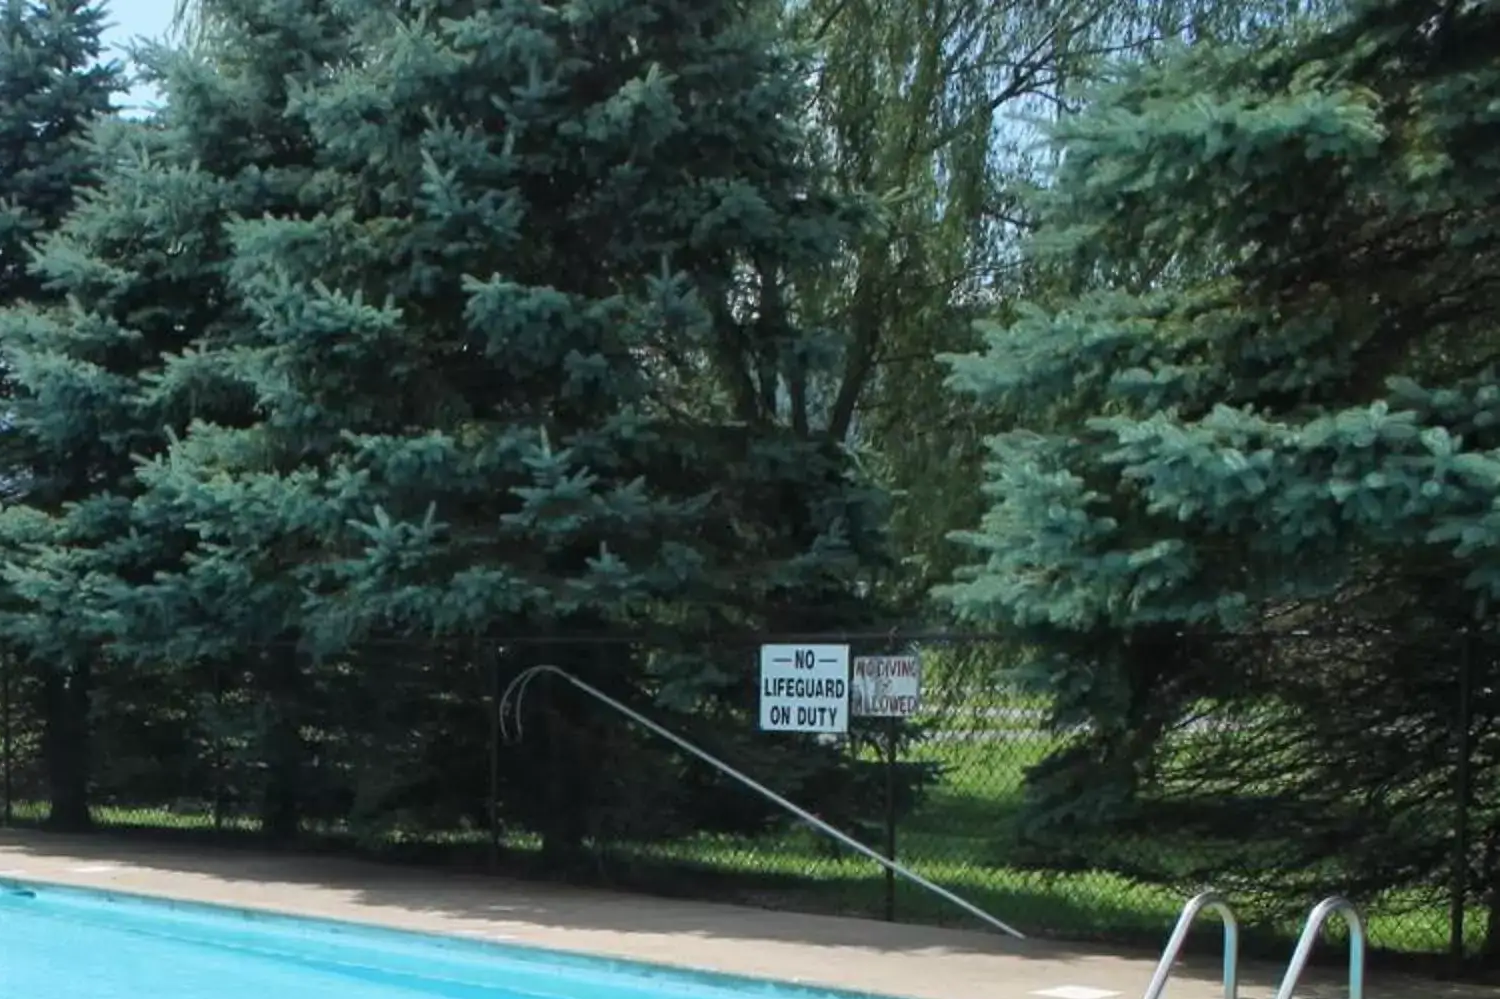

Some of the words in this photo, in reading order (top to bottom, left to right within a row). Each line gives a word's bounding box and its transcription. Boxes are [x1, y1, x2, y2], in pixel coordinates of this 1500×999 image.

[795, 650, 815, 669] NO
[764, 679, 845, 699] LIFEGUARD
[770, 706, 790, 725] ON
[797, 707, 838, 726] DUTY
